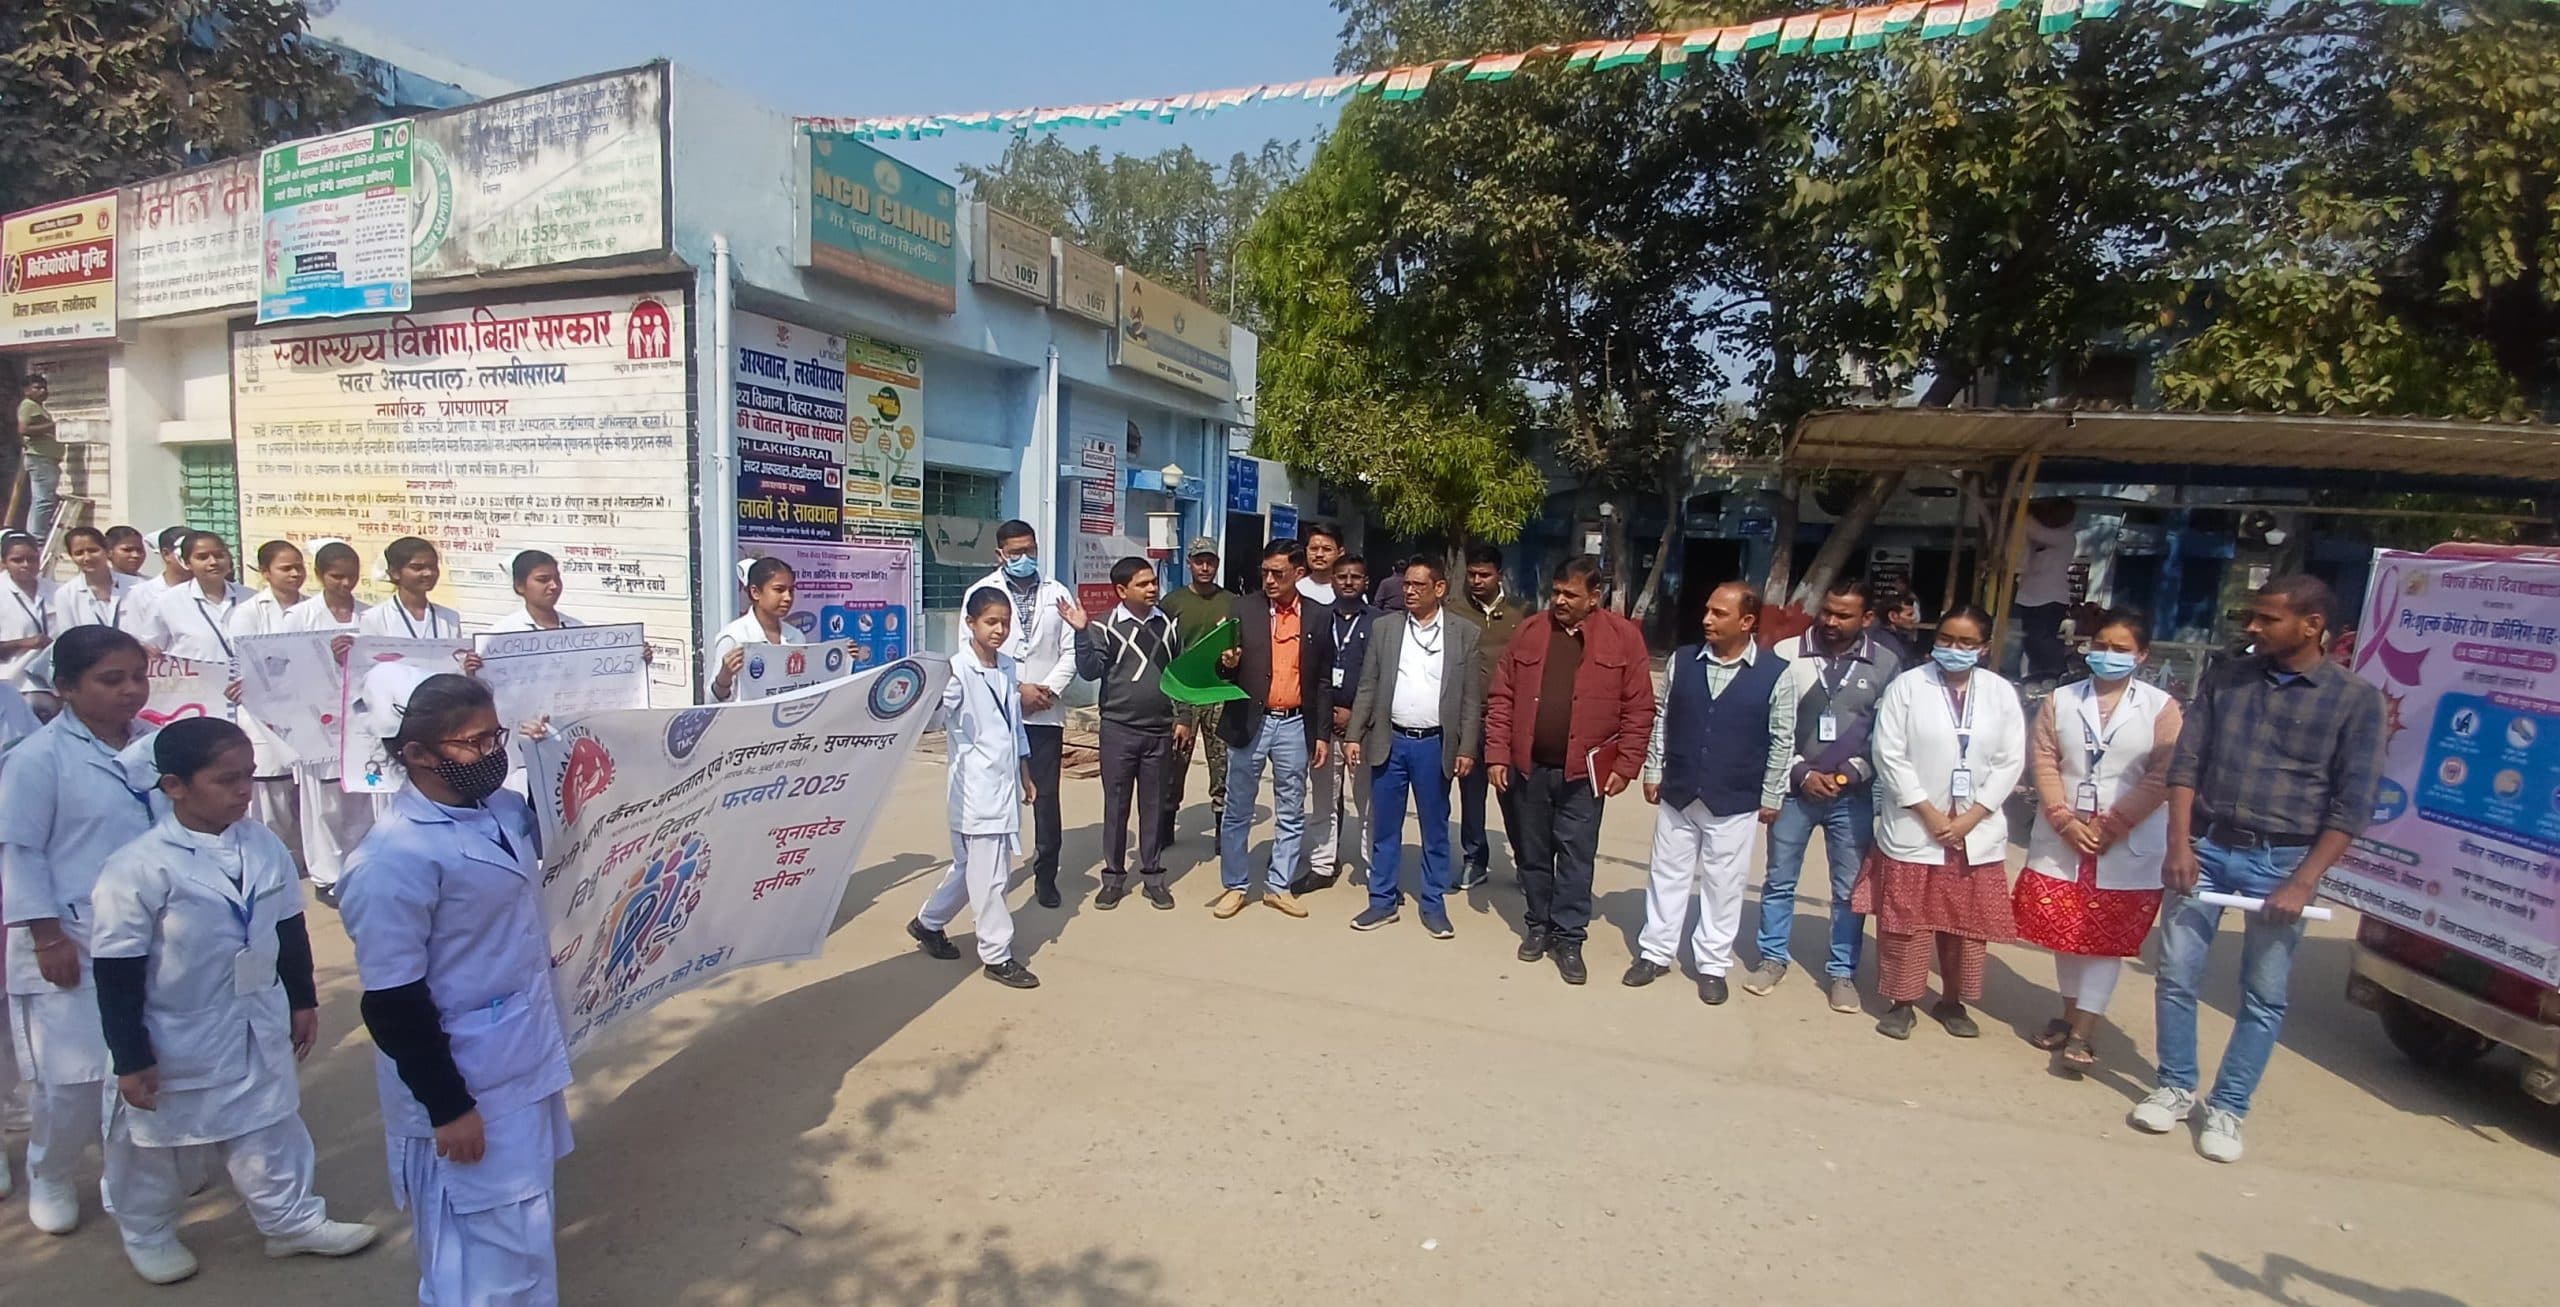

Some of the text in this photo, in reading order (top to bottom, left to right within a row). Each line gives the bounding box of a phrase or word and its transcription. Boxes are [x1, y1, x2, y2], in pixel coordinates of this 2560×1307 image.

[816, 168, 870, 215] NCD
[877, 196, 951, 248] CLINIC
[516, 223, 558, 245] 14555
[81, 247, 108, 276] यूनिट
[1016, 264, 1039, 286] 1097
[1087, 293, 1106, 312] 1097
[272, 307, 615, 368] स्वास्थ्य विभाग, बिहार सरकार
[338, 373, 374, 395] सदर
[478, 356, 568, 389] लखीसराय
[794, 358, 845, 392] लखीसराय
[376, 393, 509, 419] नागरिक घोषणापत्र
[787, 394, 812, 416] बिहार
[814, 404, 844, 422] सरकार
[752, 411, 782, 434] बोतल
[785, 420, 810, 441] मुक्त
[753, 441, 829, 461] LAKHISARAI
[738, 495, 839, 525] लालों से सावधान
[2441, 572, 2466, 589] विश्व
[2442, 612, 2469, 635] कैंसर
[2470, 614, 2489, 637] रोग
[487, 630, 634, 655] WORLD CANCER DAY
[144, 655, 200, 678] ICAL
[592, 654, 635, 675] 2025
[676, 735, 695, 751] TMC
[607, 798, 654, 824] कैंसर
[652, 766, 707, 808] अस्पताल
[707, 752, 724, 779] एवं
[724, 739, 790, 766] अनुसंधान
[789, 732, 818, 753] केंद्र,
[824, 732, 899, 754] मुजफ्फरपुर
[601, 833, 652, 876] कैंसर
[650, 806, 707, 848] दिवस
[721, 774, 789, 810] फरवरी
[788, 773, 850, 798] 2025
[624, 975, 670, 1009] इंसान
[670, 959, 694, 983] को
